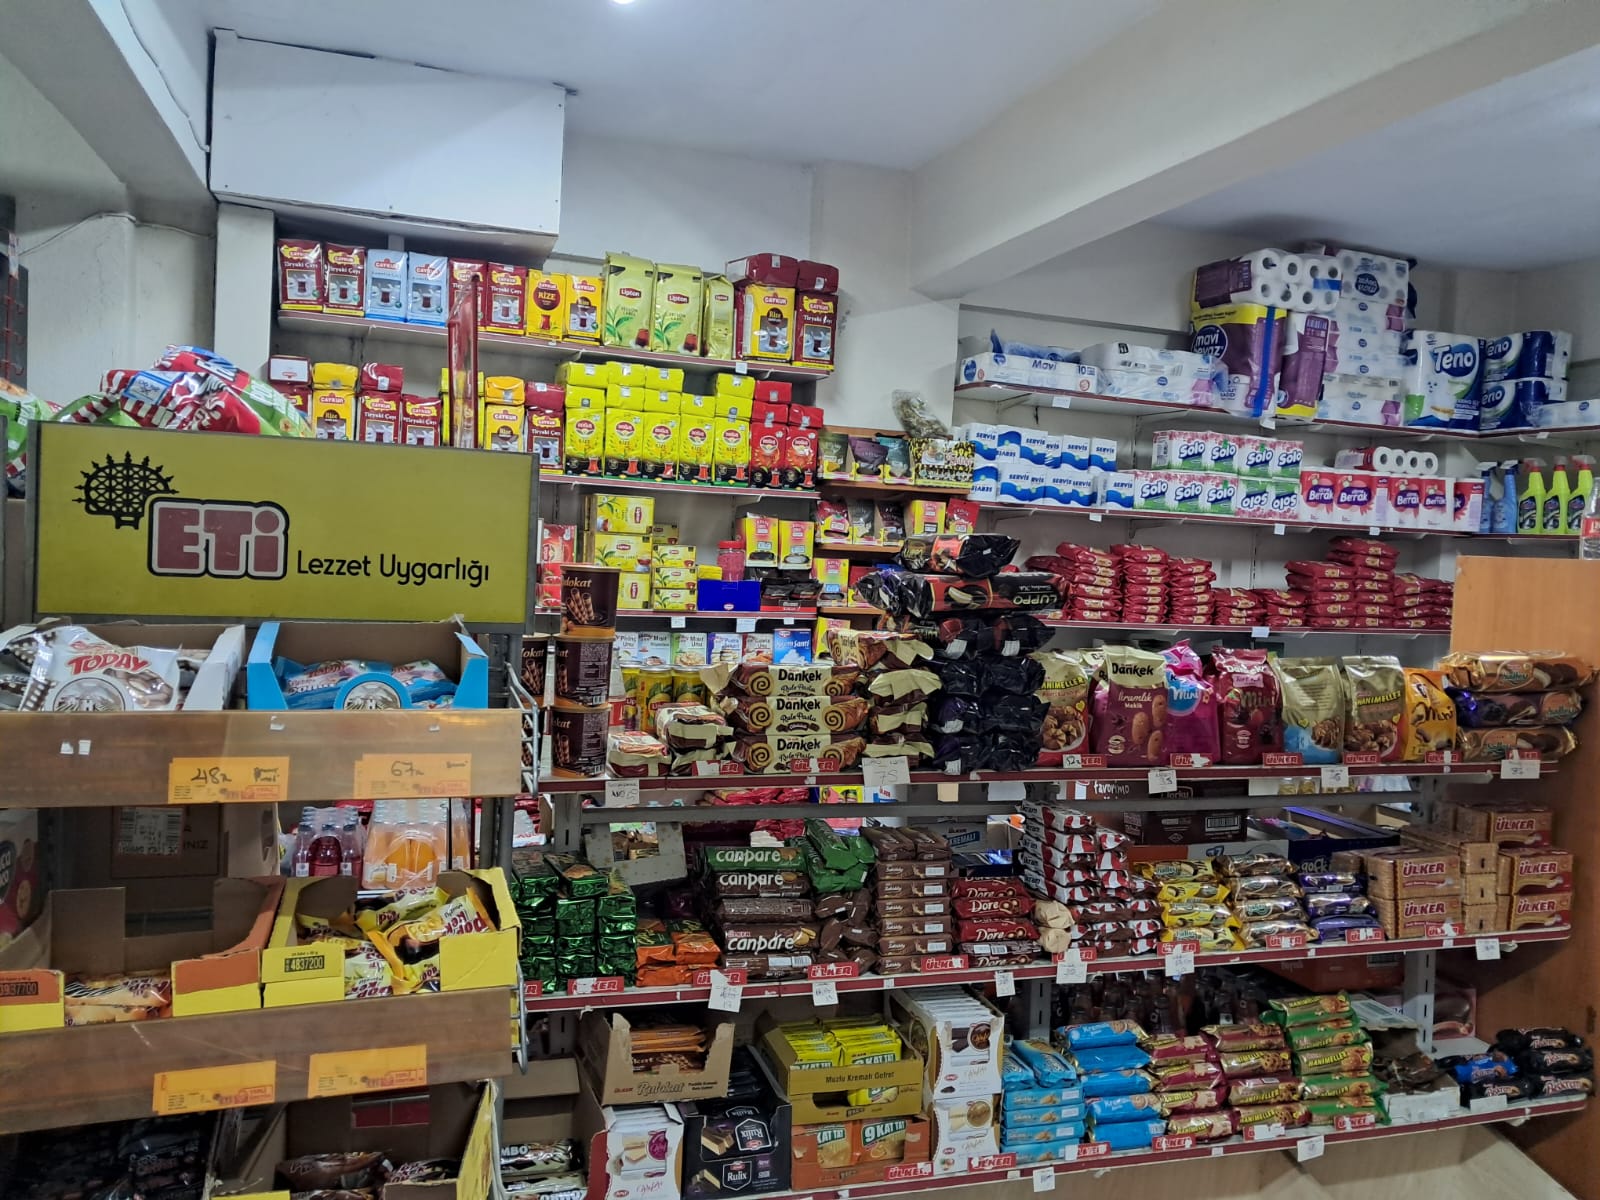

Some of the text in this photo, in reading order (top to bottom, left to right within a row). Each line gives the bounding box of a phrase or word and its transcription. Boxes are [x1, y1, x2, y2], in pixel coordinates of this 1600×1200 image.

[620, 288, 641, 298] Lipton
[668, 295, 689, 304] Lipton
[1195, 330, 1219, 346] mavi
[1487, 339, 1510, 357] eno
[1032, 360, 1057, 372] Mavi
[1433, 344, 1474, 373] Teno
[1078, 366, 1086, 375] 10
[1482, 389, 1504, 405] eno
[976, 432, 995, 441] SERVİS
[1026, 438, 1045, 446] SERVİS
[1096, 446, 1115, 454] SERVİS
[1179, 441, 1205, 459] Solo
[1211, 443, 1237, 461] Solo
[1247, 449, 1273, 466] Solo
[1278, 449, 1302, 466] Solo
[1141, 481, 1168, 498] Solo
[1175, 483, 1202, 501] Solo
[1207, 486, 1235, 502] Solo
[1309, 489, 1333, 501] Berrak
[1340, 491, 1368, 502] Berrak
[1241, 493, 1268, 510] Solo
[1272, 494, 1297, 511] Solo
[1397, 494, 1419, 505] Berra
[297, 550, 371, 577] Lezzet
[379, 552, 489, 588] Uygarlığı
[1013, 594, 1057, 605] LUPPO
[67, 653, 150, 676] TODAY
[1112, 662, 1154, 677] Dankek
[778, 668, 822, 683] Dankek
[1041, 676, 1085, 690] ANIMELLER
[776, 698, 821, 713] Dankek
[777, 738, 821, 752] Dankek
[1496, 817, 1536, 831] ÜLKER
[716, 849, 781, 866] canpare
[1403, 861, 1445, 876] ÜLKER
[1519, 861, 1557, 875] ÜLKER
[719, 873, 784, 890] canpare
[972, 900, 999, 913] Dore
[1404, 901, 1445, 916] ÜLKER
[1517, 899, 1555, 913] ÜLKER
[976, 928, 1005, 941] Dore
[728, 936, 794, 954] canpare
[290, 956, 324, 970] 4837200
[1308, 1050, 1348, 1067] HANIMELLER
[637, 1081, 685, 1096] Rulokat
[740, 1128, 763, 1139] Rulix
[864, 1127, 875, 1142] 9
[875, 1122, 894, 1137] KAT
[501, 1146, 528, 1156] MBO
[727, 1170, 747, 1181] Rulix
